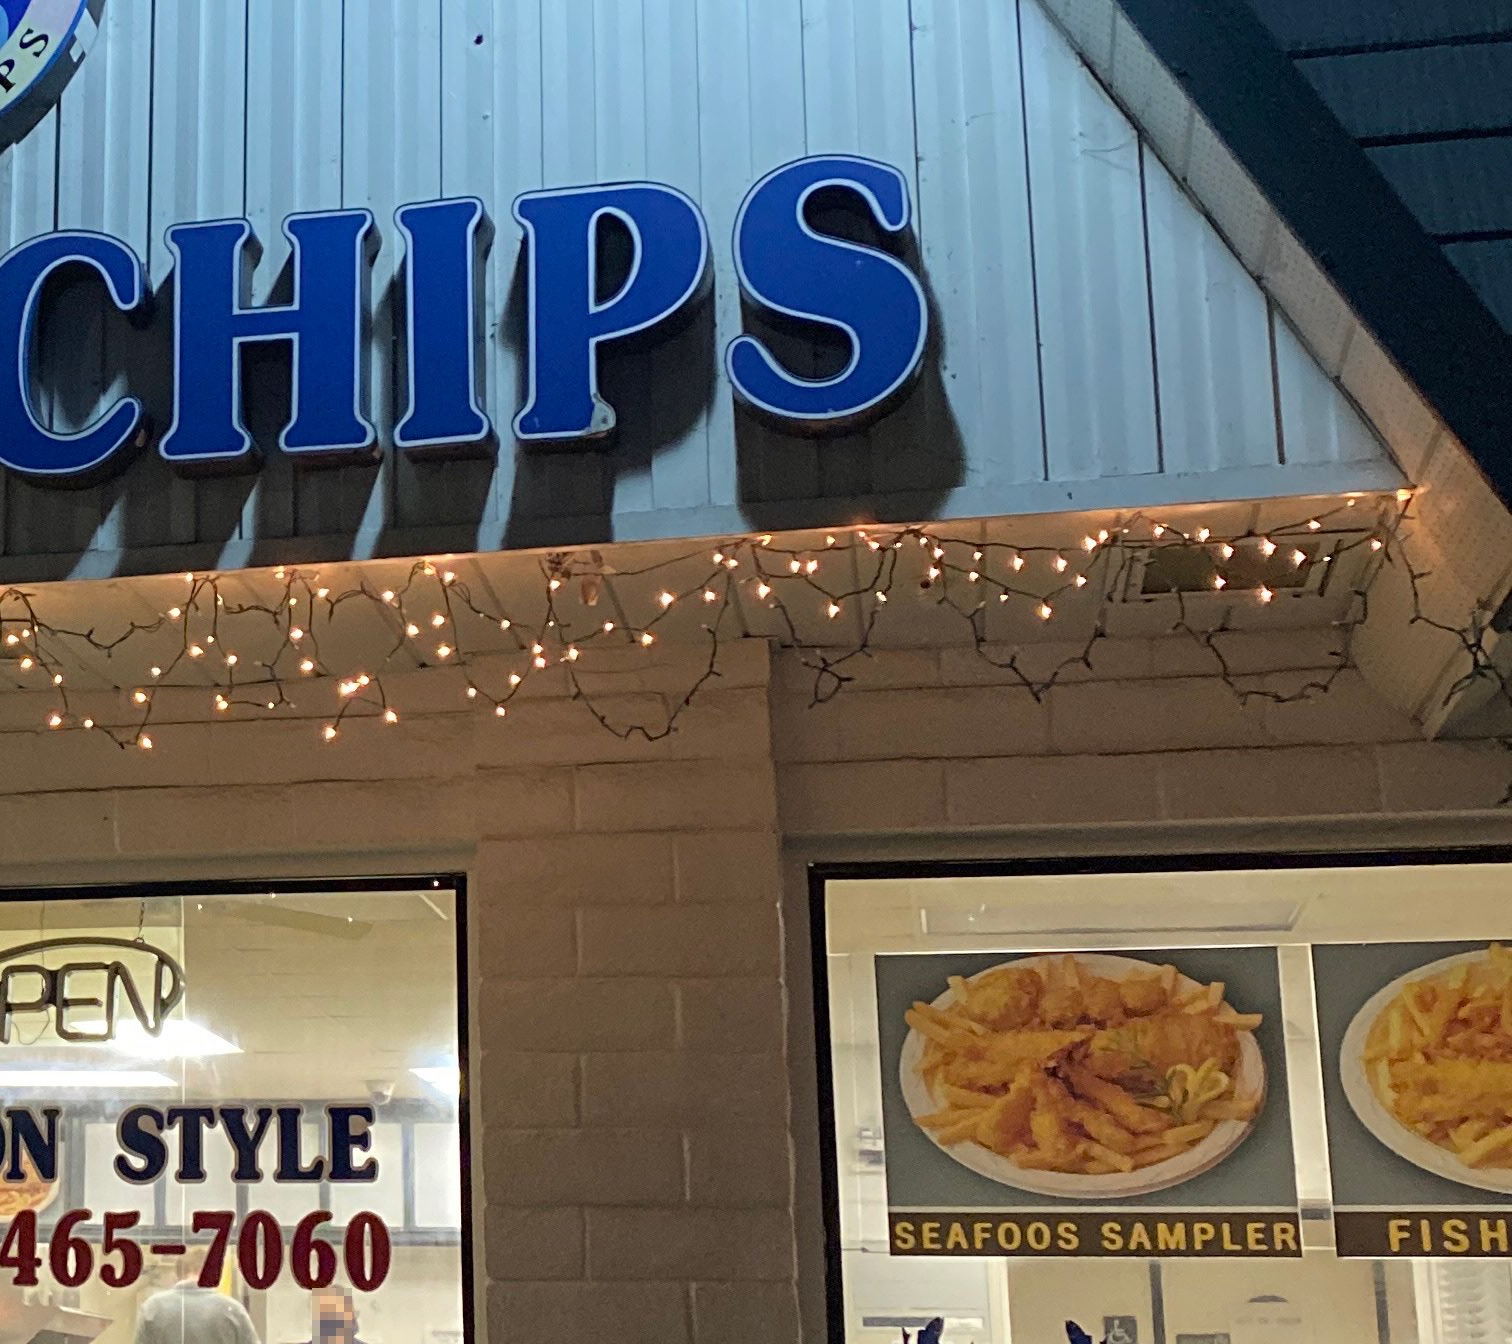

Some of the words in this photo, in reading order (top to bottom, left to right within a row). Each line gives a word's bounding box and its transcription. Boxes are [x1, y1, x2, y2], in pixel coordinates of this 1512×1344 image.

[114, 1106, 378, 1185] STYLE
[894, 1221, 1080, 1251] SEAFOOS
[1101, 1221, 1298, 1251] SAMPLER
[1389, 1219, 1508, 1252] FISH
